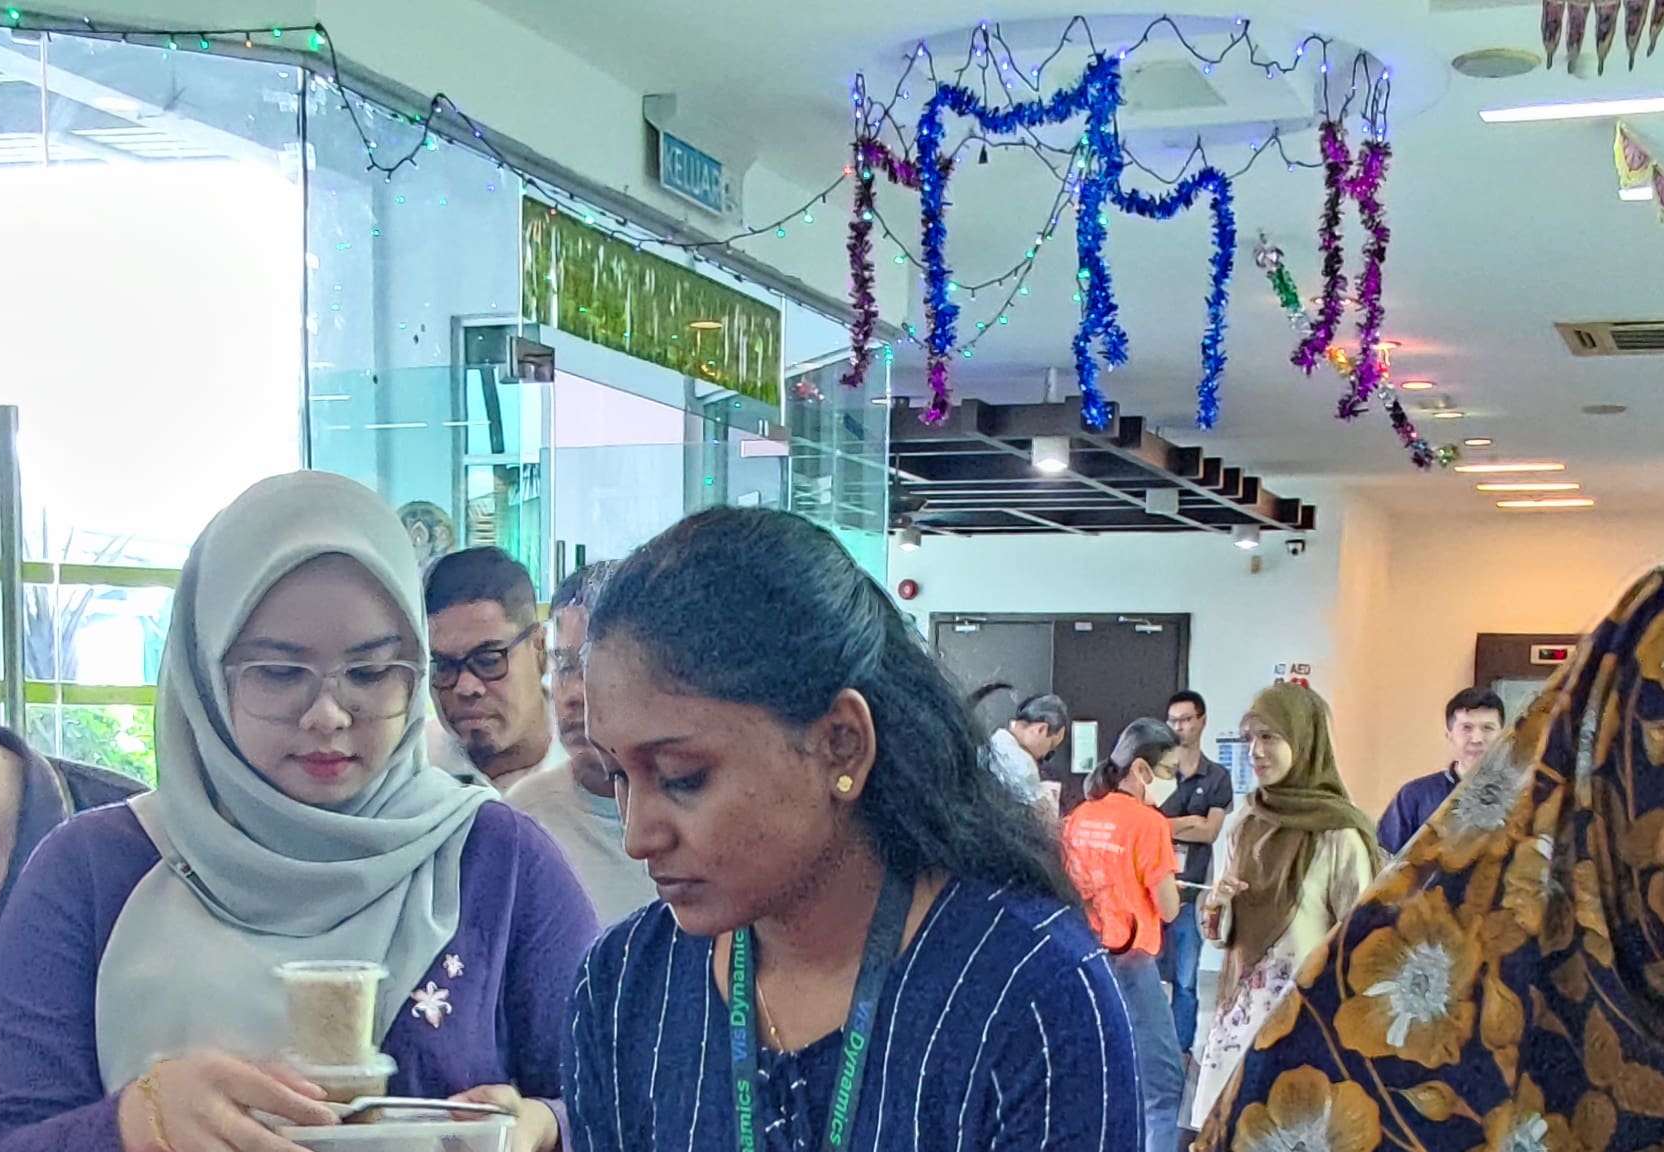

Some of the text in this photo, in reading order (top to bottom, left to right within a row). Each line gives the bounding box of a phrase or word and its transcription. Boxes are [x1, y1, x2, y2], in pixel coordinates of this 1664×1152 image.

[663, 142, 721, 206] KELUAR
[1290, 663, 1311, 675] AED
[730, 929, 750, 1062] VisDynamic
[830, 1000, 874, 1147] VisDynamics
